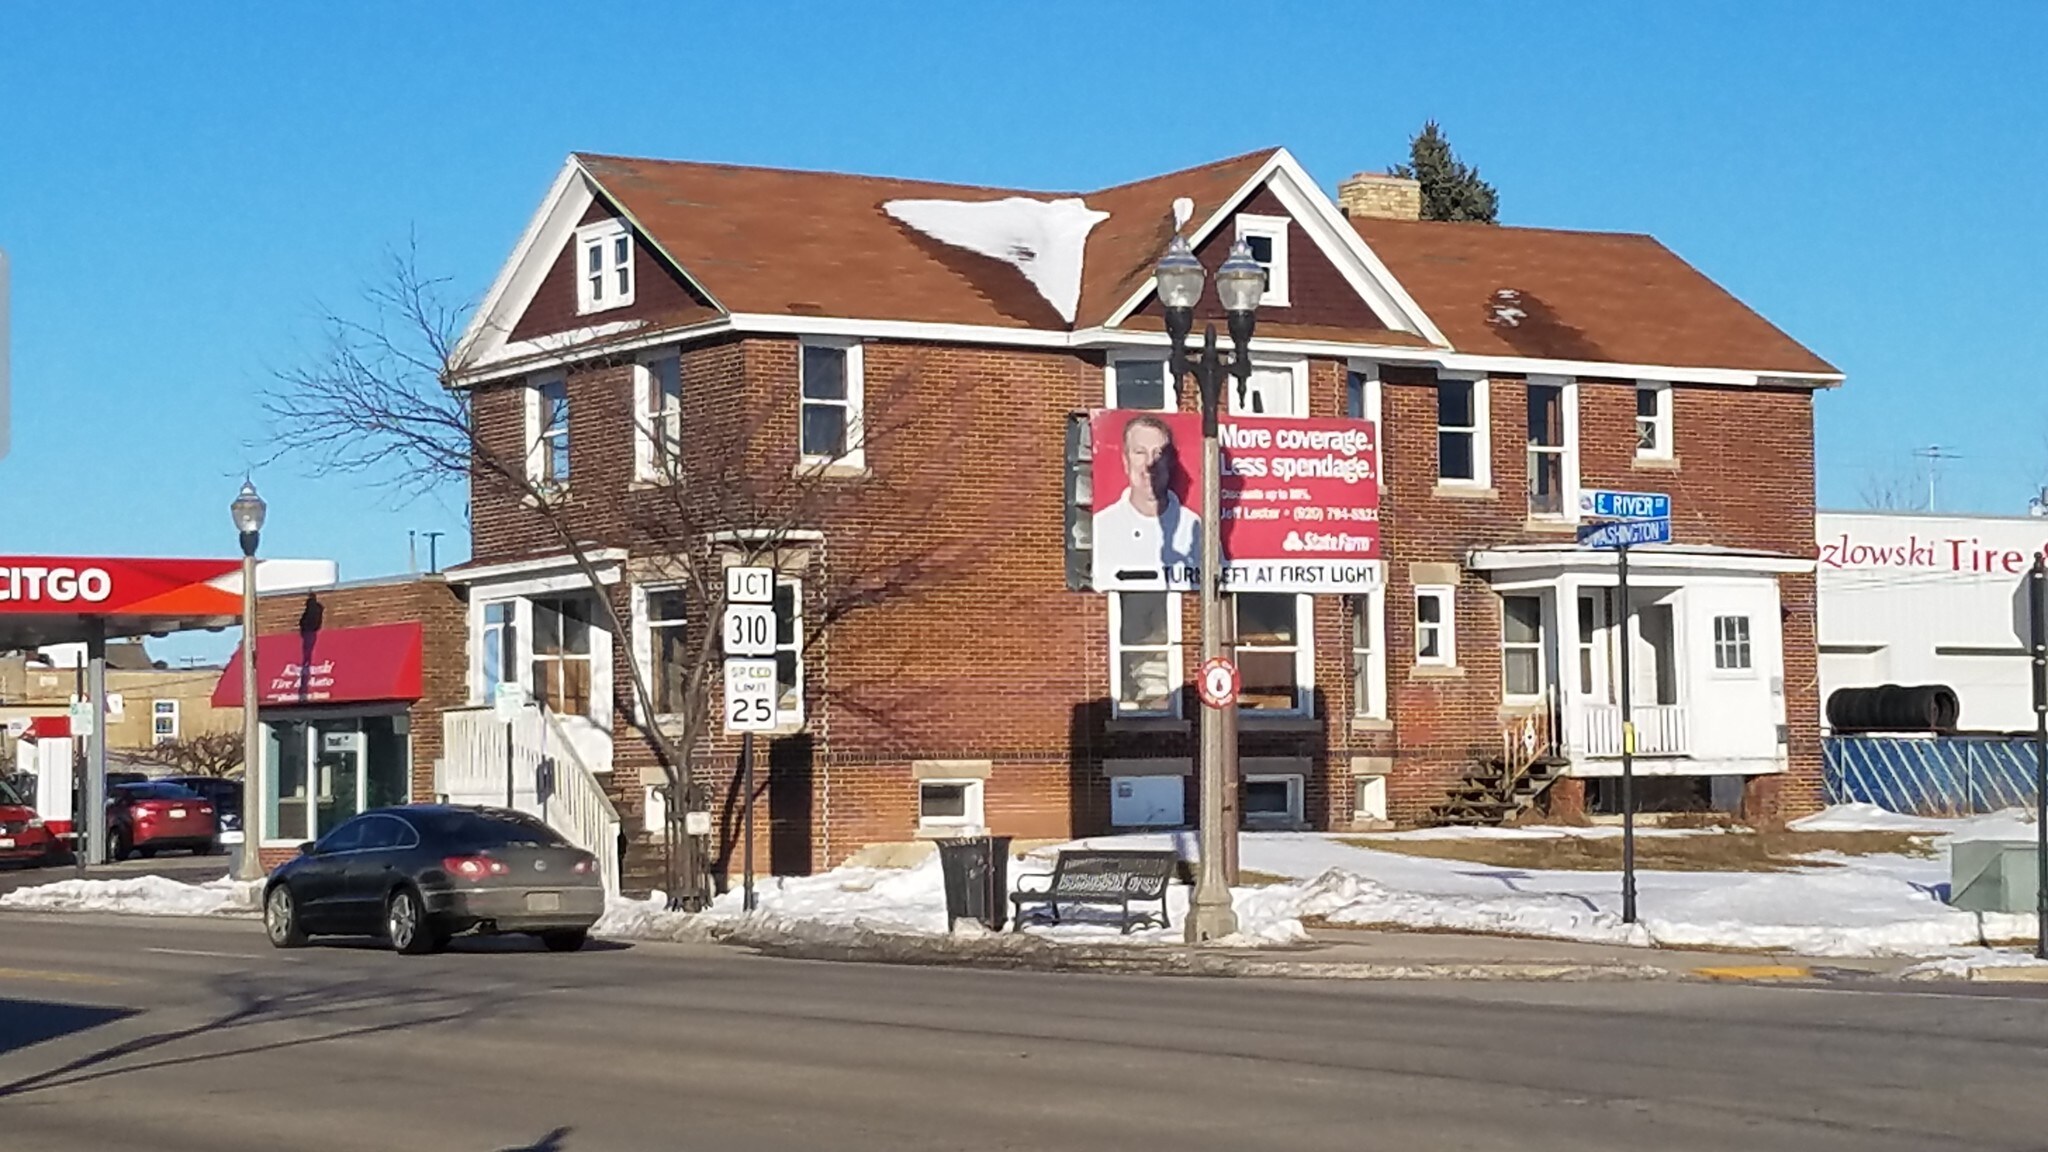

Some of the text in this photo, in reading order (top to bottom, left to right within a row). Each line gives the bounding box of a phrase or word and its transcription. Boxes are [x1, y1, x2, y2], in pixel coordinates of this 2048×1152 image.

[1218, 424, 1373, 455] More coverage.
[1220, 453, 1375, 484] Less spendage.
[1597, 495, 1608, 513] E
[1613, 496, 1653, 516] RIVER
[1945, 538, 2023, 573] Tire
[733, 573, 768, 596] JCT
[1218, 566, 1249, 583] EFT
[1256, 567, 1273, 582] AT
[1280, 567, 1324, 583] FIRST
[1331, 567, 1375, 583] LIGHT
[732, 615, 767, 645] 310
[731, 667, 772, 678] SPEED
[735, 683, 767, 693] LIMIT
[732, 699, 771, 722] 25
